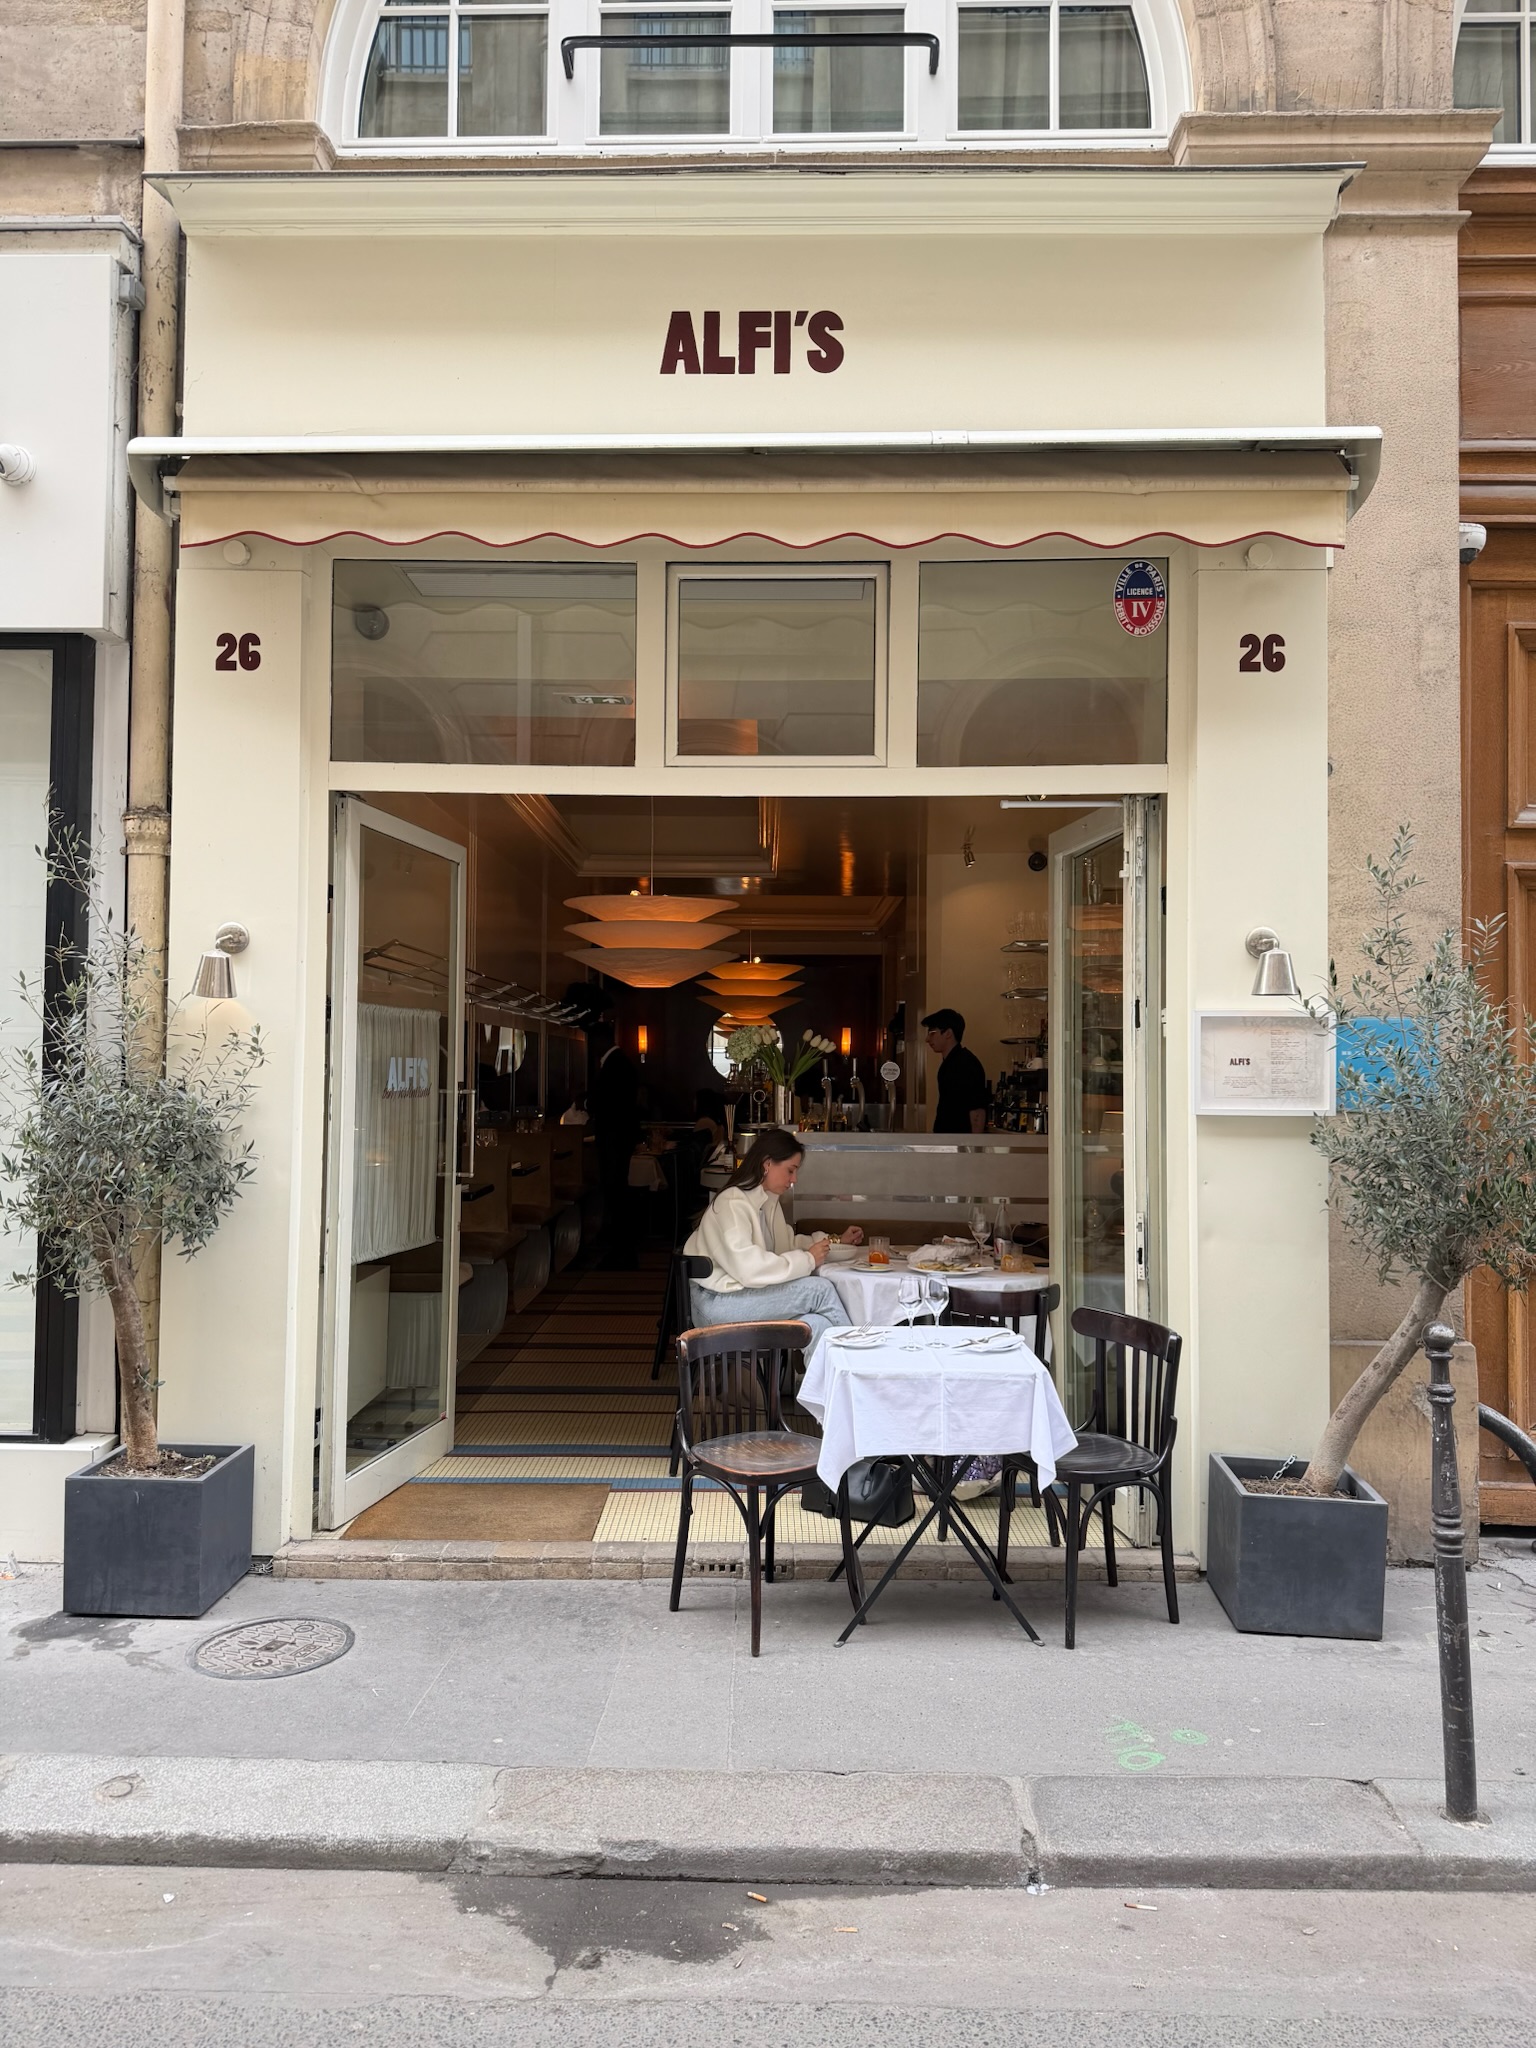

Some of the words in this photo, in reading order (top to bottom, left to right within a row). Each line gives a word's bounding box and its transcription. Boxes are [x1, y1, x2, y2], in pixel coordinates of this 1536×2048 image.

[660, 310, 845, 375] ALFI'S
[1116, 568, 1132, 592] VILLE
[1145, 565, 1164, 592] PARIS
[1131, 601, 1152, 618] IV
[1134, 601, 1164, 635] BOISSONS
[215, 632, 261, 671] 26
[1239, 633, 1286, 673] 26
[387, 1056, 429, 1091] ALFI'S
[1229, 1057, 1251, 1066] ALFI'S
